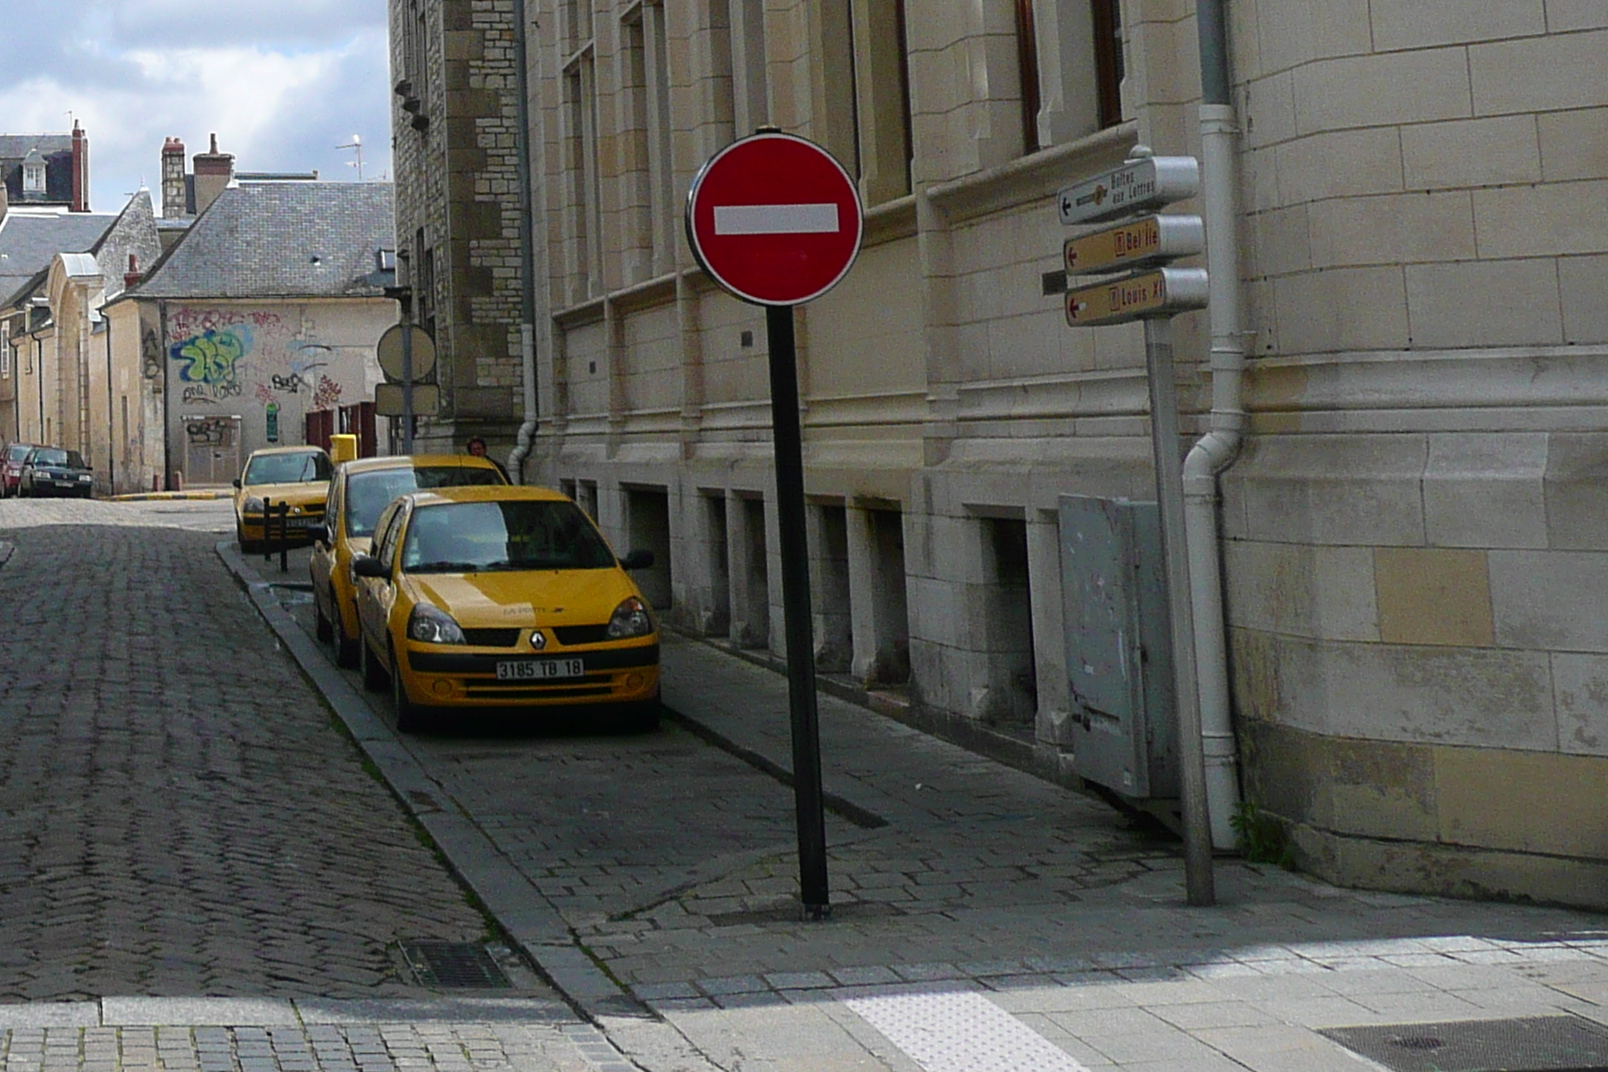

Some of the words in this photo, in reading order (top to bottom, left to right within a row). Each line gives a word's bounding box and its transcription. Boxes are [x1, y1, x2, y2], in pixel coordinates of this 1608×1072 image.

[1122, 284, 1146, 305] Louis
[499, 661, 534, 678] 3185
[540, 661, 557, 676] TB
[565, 660, 581, 675] 18
